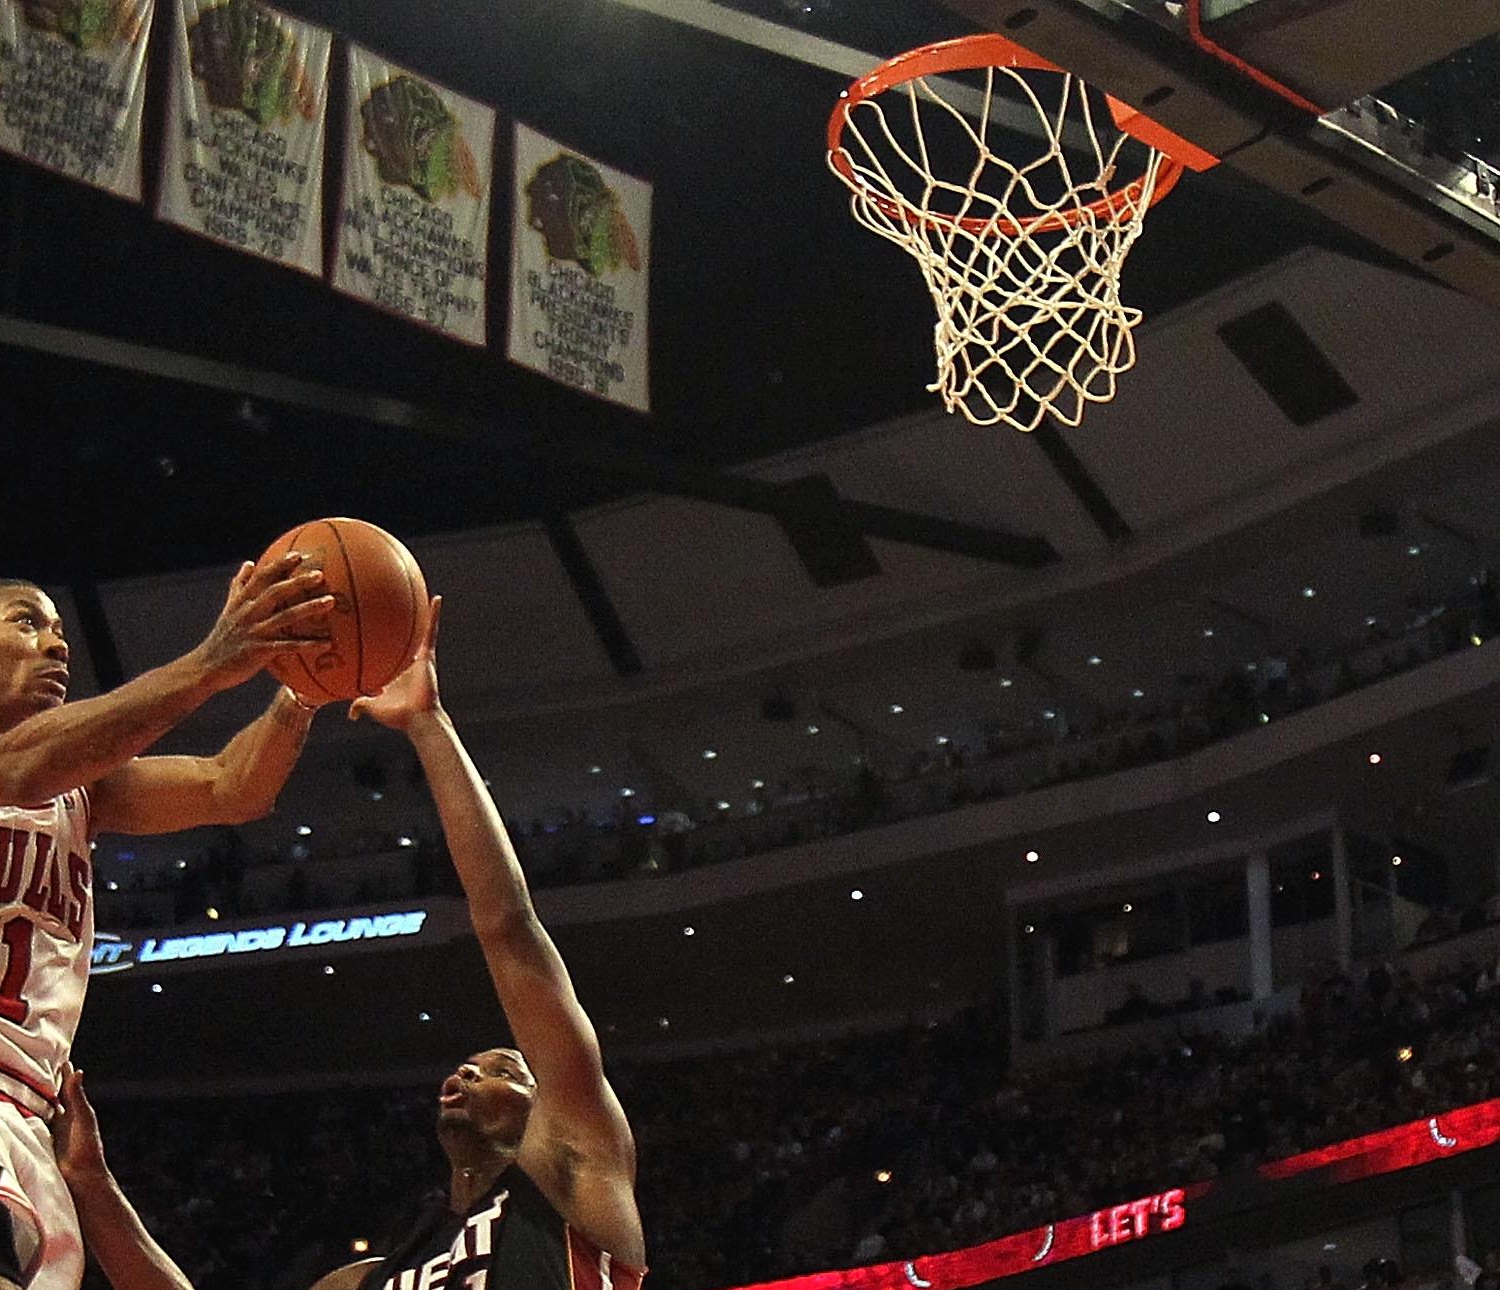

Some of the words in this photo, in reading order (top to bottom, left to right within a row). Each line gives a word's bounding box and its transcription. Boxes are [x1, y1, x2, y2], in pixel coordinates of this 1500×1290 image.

[137, 926, 287, 963] LEGENDS
[288, 910, 427, 947] LOUNGE
[1091, 1187, 1186, 1251] LET'S
